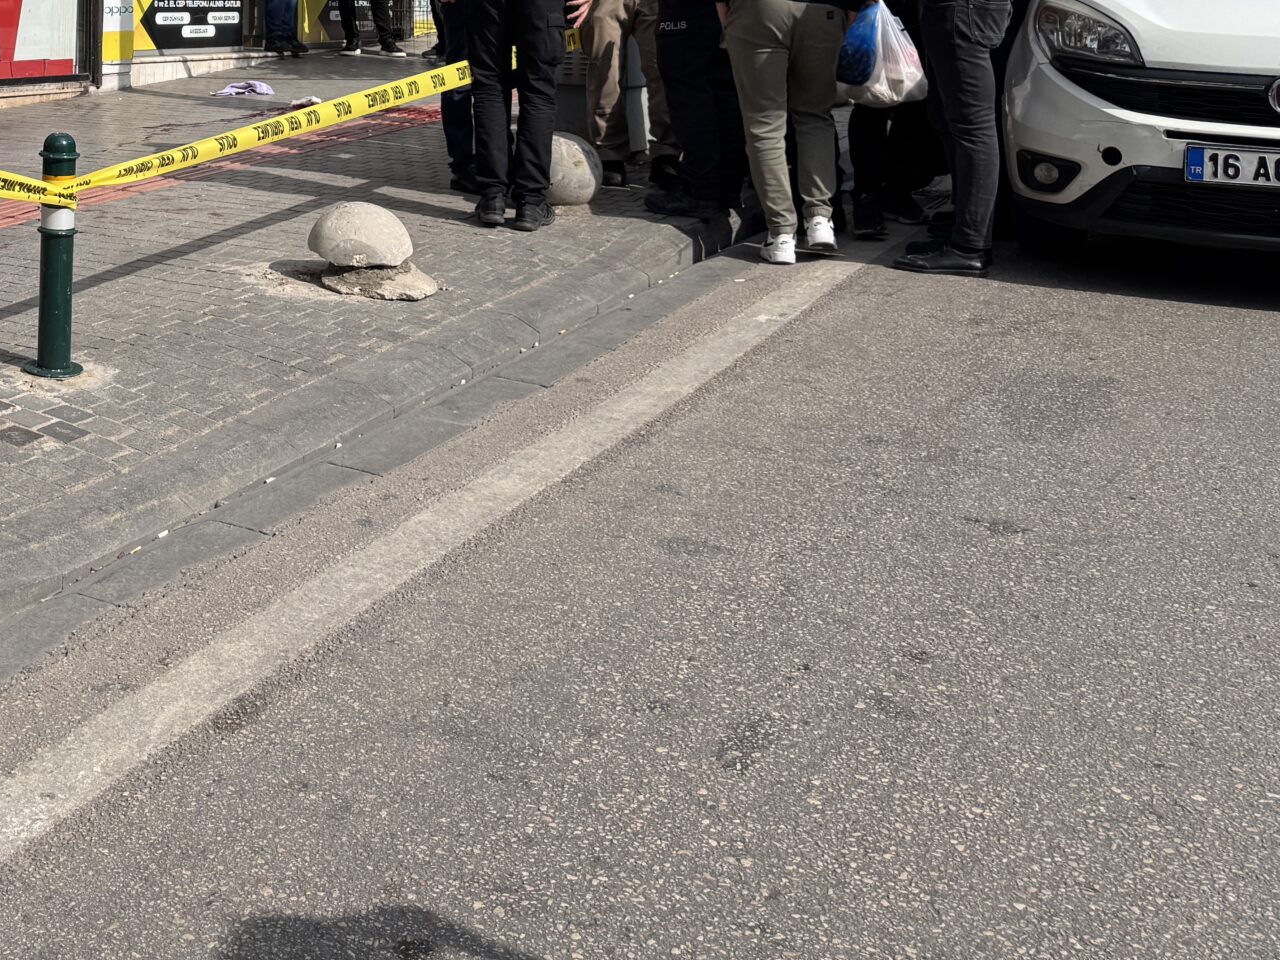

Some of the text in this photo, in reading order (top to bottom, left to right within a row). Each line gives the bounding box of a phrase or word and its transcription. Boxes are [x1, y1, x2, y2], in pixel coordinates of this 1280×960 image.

[176, 0, 186, 8] CEP
[186, 0, 210, 8] TELEFONU
[430, 73, 447, 91] POLİS
[303, 109, 321, 127] OLAY
[334, 100, 353, 119] POLİS
[214, 134, 238, 155] POLİS
[1190, 166, 1202, 174] TR
[1209, 153, 1241, 179] 16
